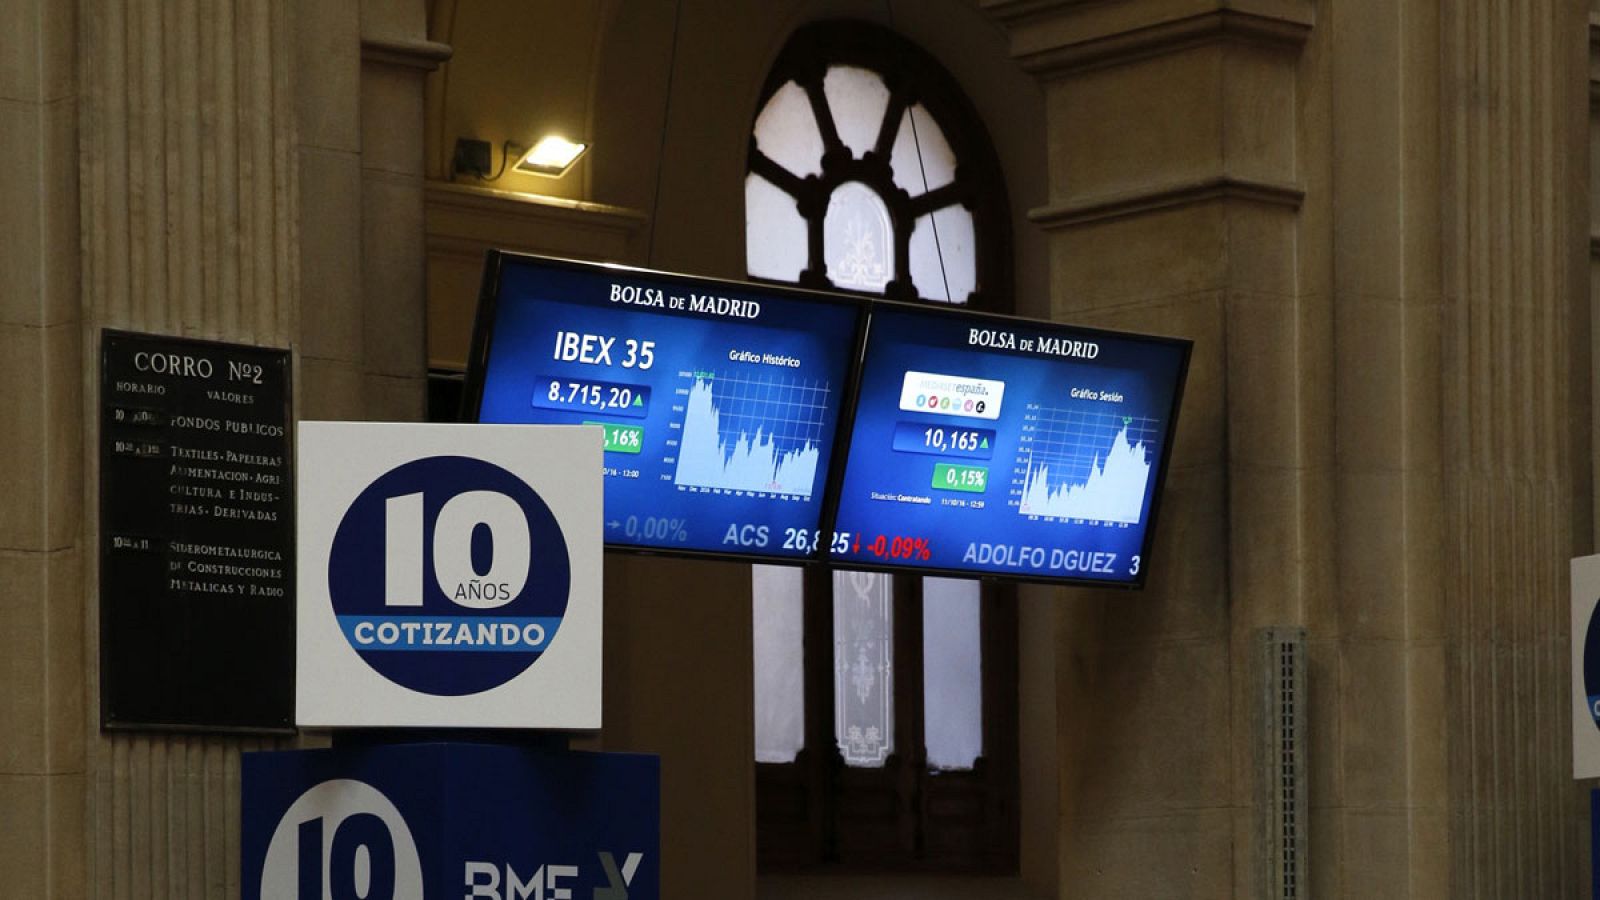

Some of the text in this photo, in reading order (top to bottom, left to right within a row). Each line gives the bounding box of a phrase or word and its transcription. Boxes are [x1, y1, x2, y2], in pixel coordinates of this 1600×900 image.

[609, 283, 761, 319] BOLSA DE MADRID
[553, 330, 656, 370] IBEX 35
[968, 328, 1099, 360] BOLSA DE MADRID
[134, 352, 213, 378] CORRO
[728, 349, 801, 368] Gráfico Histórico
[116, 381, 166, 395] HORARIO
[207, 391, 255, 404] VALORES
[547, 381, 632, 410] 8.715,20
[1070, 387, 1124, 403] Gráfico Sesión
[603, 427, 640, 448] ,16%
[924, 427, 978, 452] 10,165
[946, 467, 986, 487] 0,15%
[897, 493, 932, 505] Contratando
[214, 506, 277, 521] DERIVADAS
[624, 515, 689, 542] 0,00%
[722, 523, 770, 548] ACS
[384, 490, 532, 609] 10
[866, 534, 932, 561] -0,09%
[962, 542, 1141, 576] ADOLFO DGUEZ 3
[187, 560, 282, 578] CONSTRUCCIONES
[237, 584, 245, 594] Y
[250, 584, 284, 597] RADIO
[454, 579, 511, 601] AÑOS
[354, 622, 545, 648] COTIZANDO
[298, 813, 396, 900] 10
